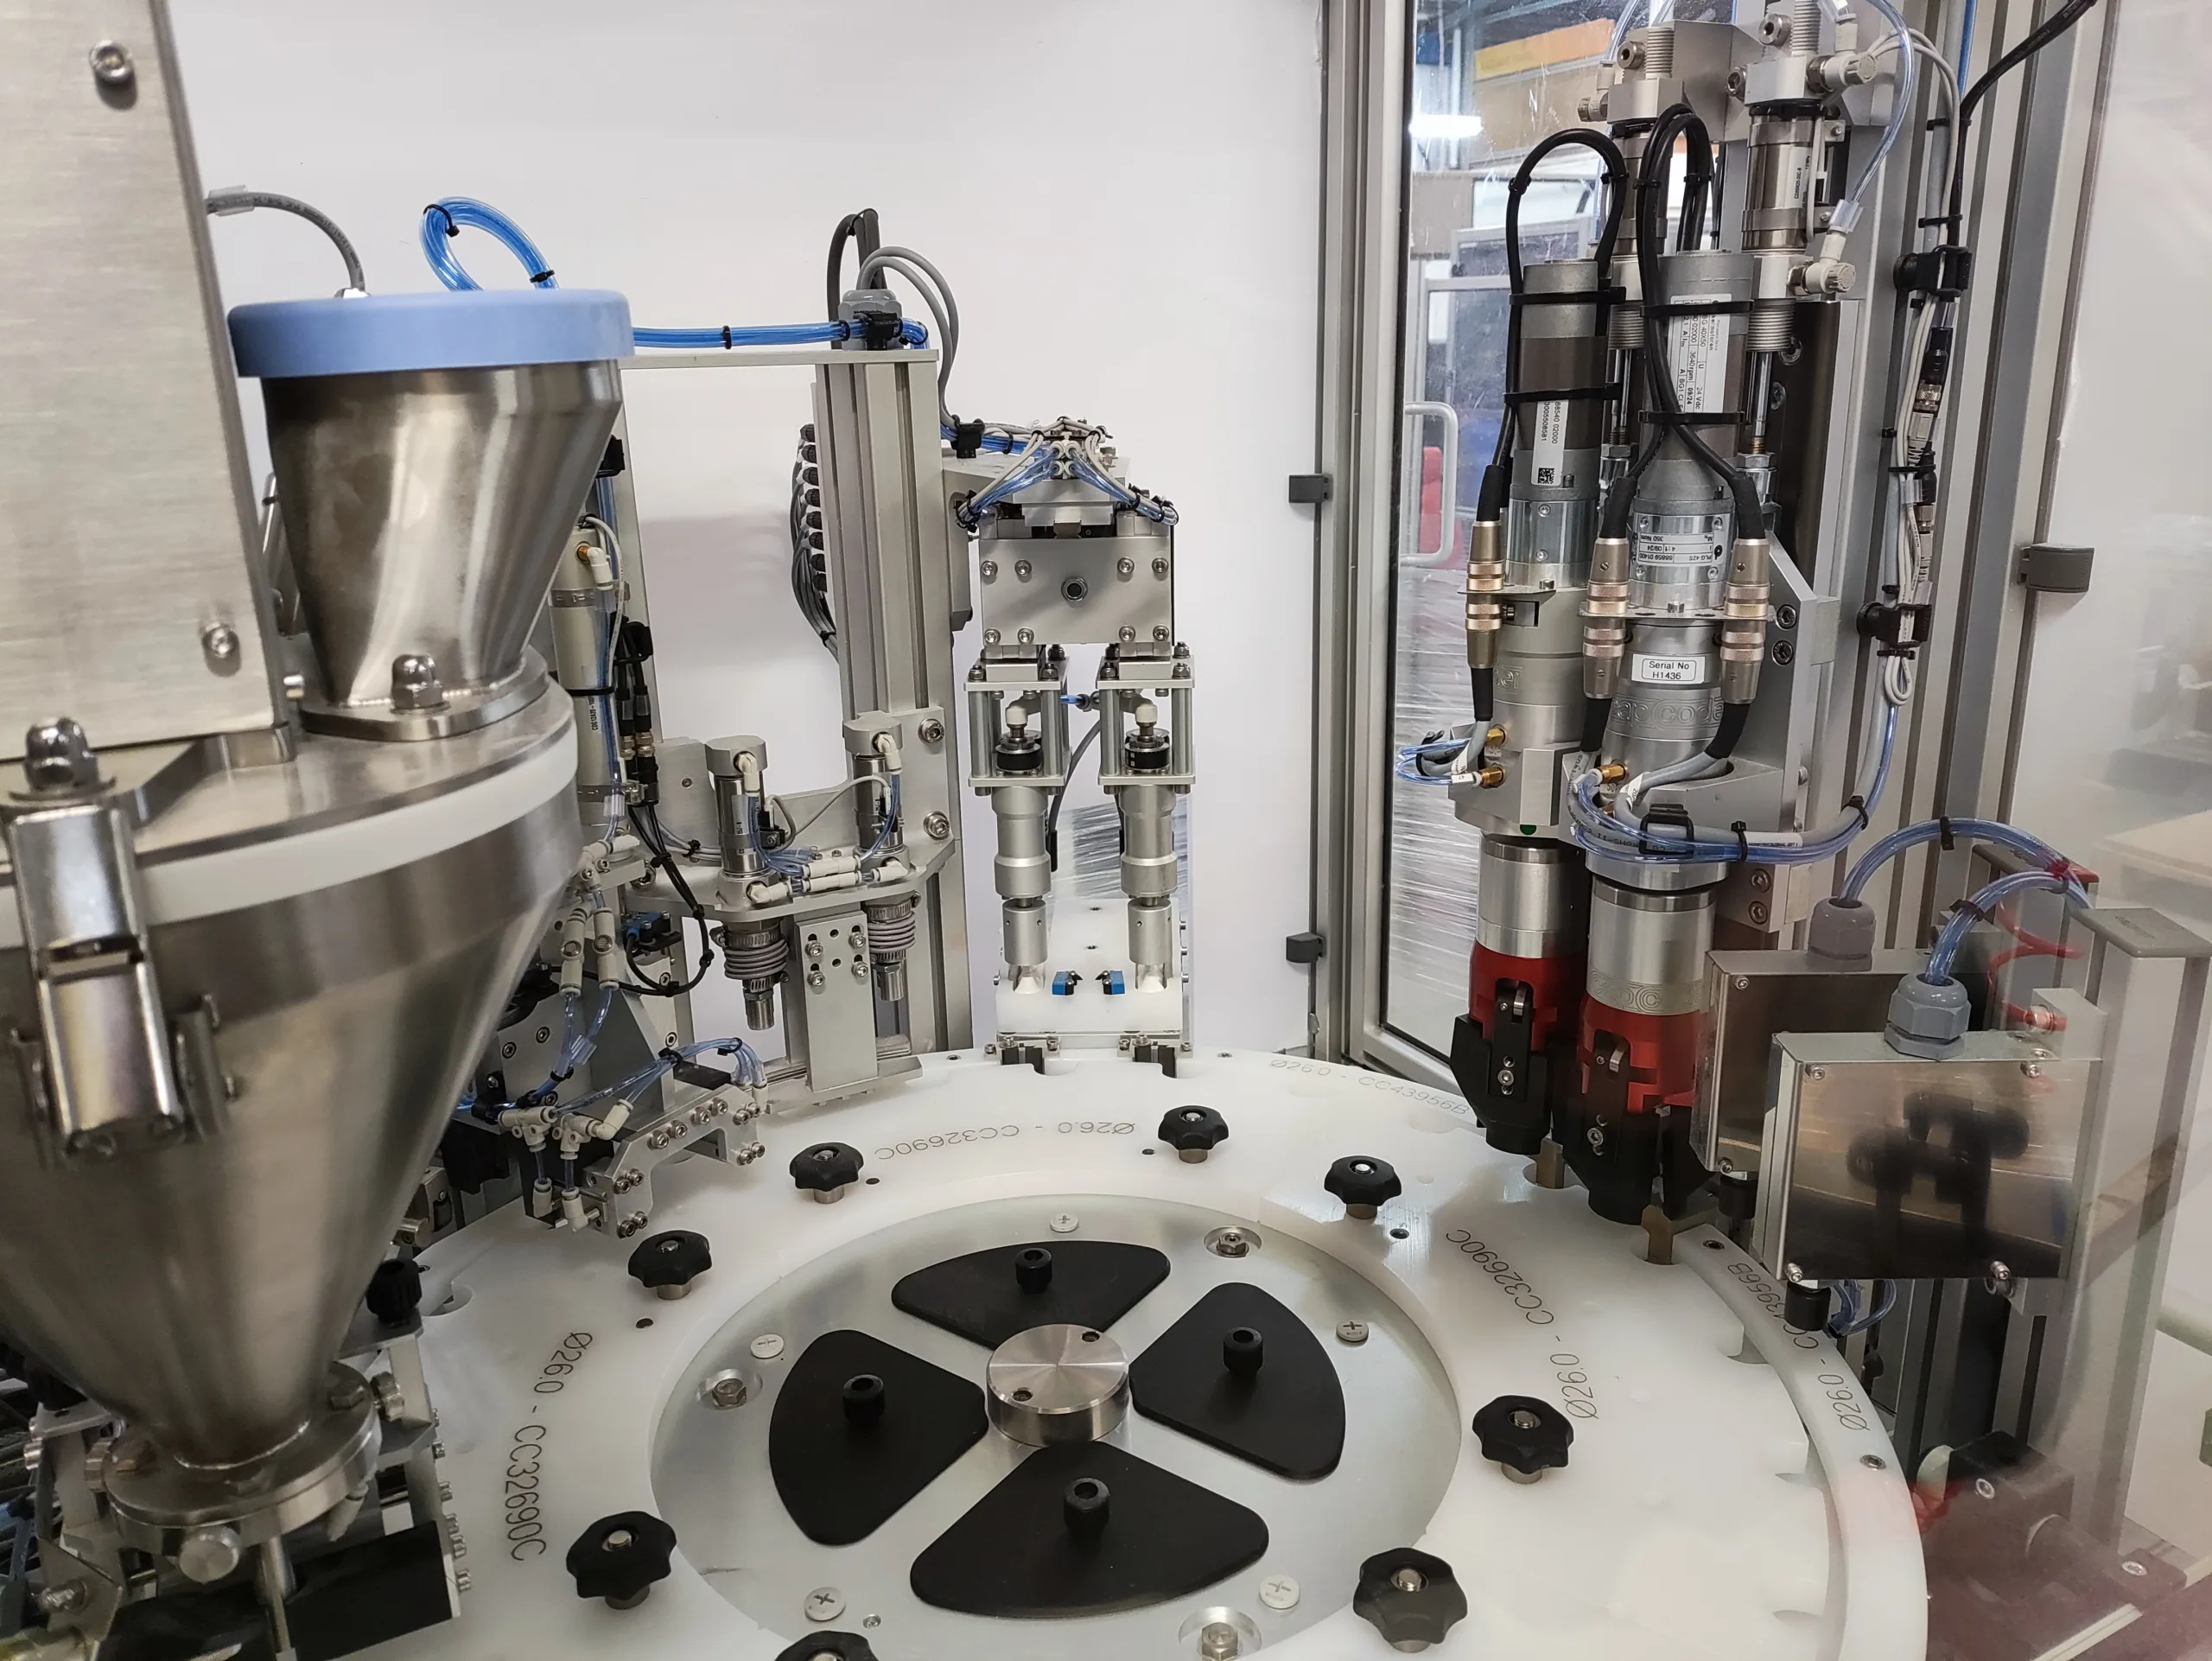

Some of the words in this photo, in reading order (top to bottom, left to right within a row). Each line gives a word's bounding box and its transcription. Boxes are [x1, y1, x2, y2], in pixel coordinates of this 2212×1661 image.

[1696, 386, 1702, 395] 24
[1649, 661, 1675, 670] Serial
[1652, 671, 1681, 680] H1436
[1357, 1077, 1471, 1116] CC43956B
[874, 1124, 1020, 1161] CC32690C
[1058, 1122, 1136, 1136] Ø26.0
[1446, 1229, 1555, 1326] CC32690C
[533, 1331, 594, 1395] Ø26.0
[1549, 1352, 1600, 1420] Ø26.0
[1817, 1373, 1872, 1432] Ø26.0
[504, 1424, 548, 1562] CC32690C
